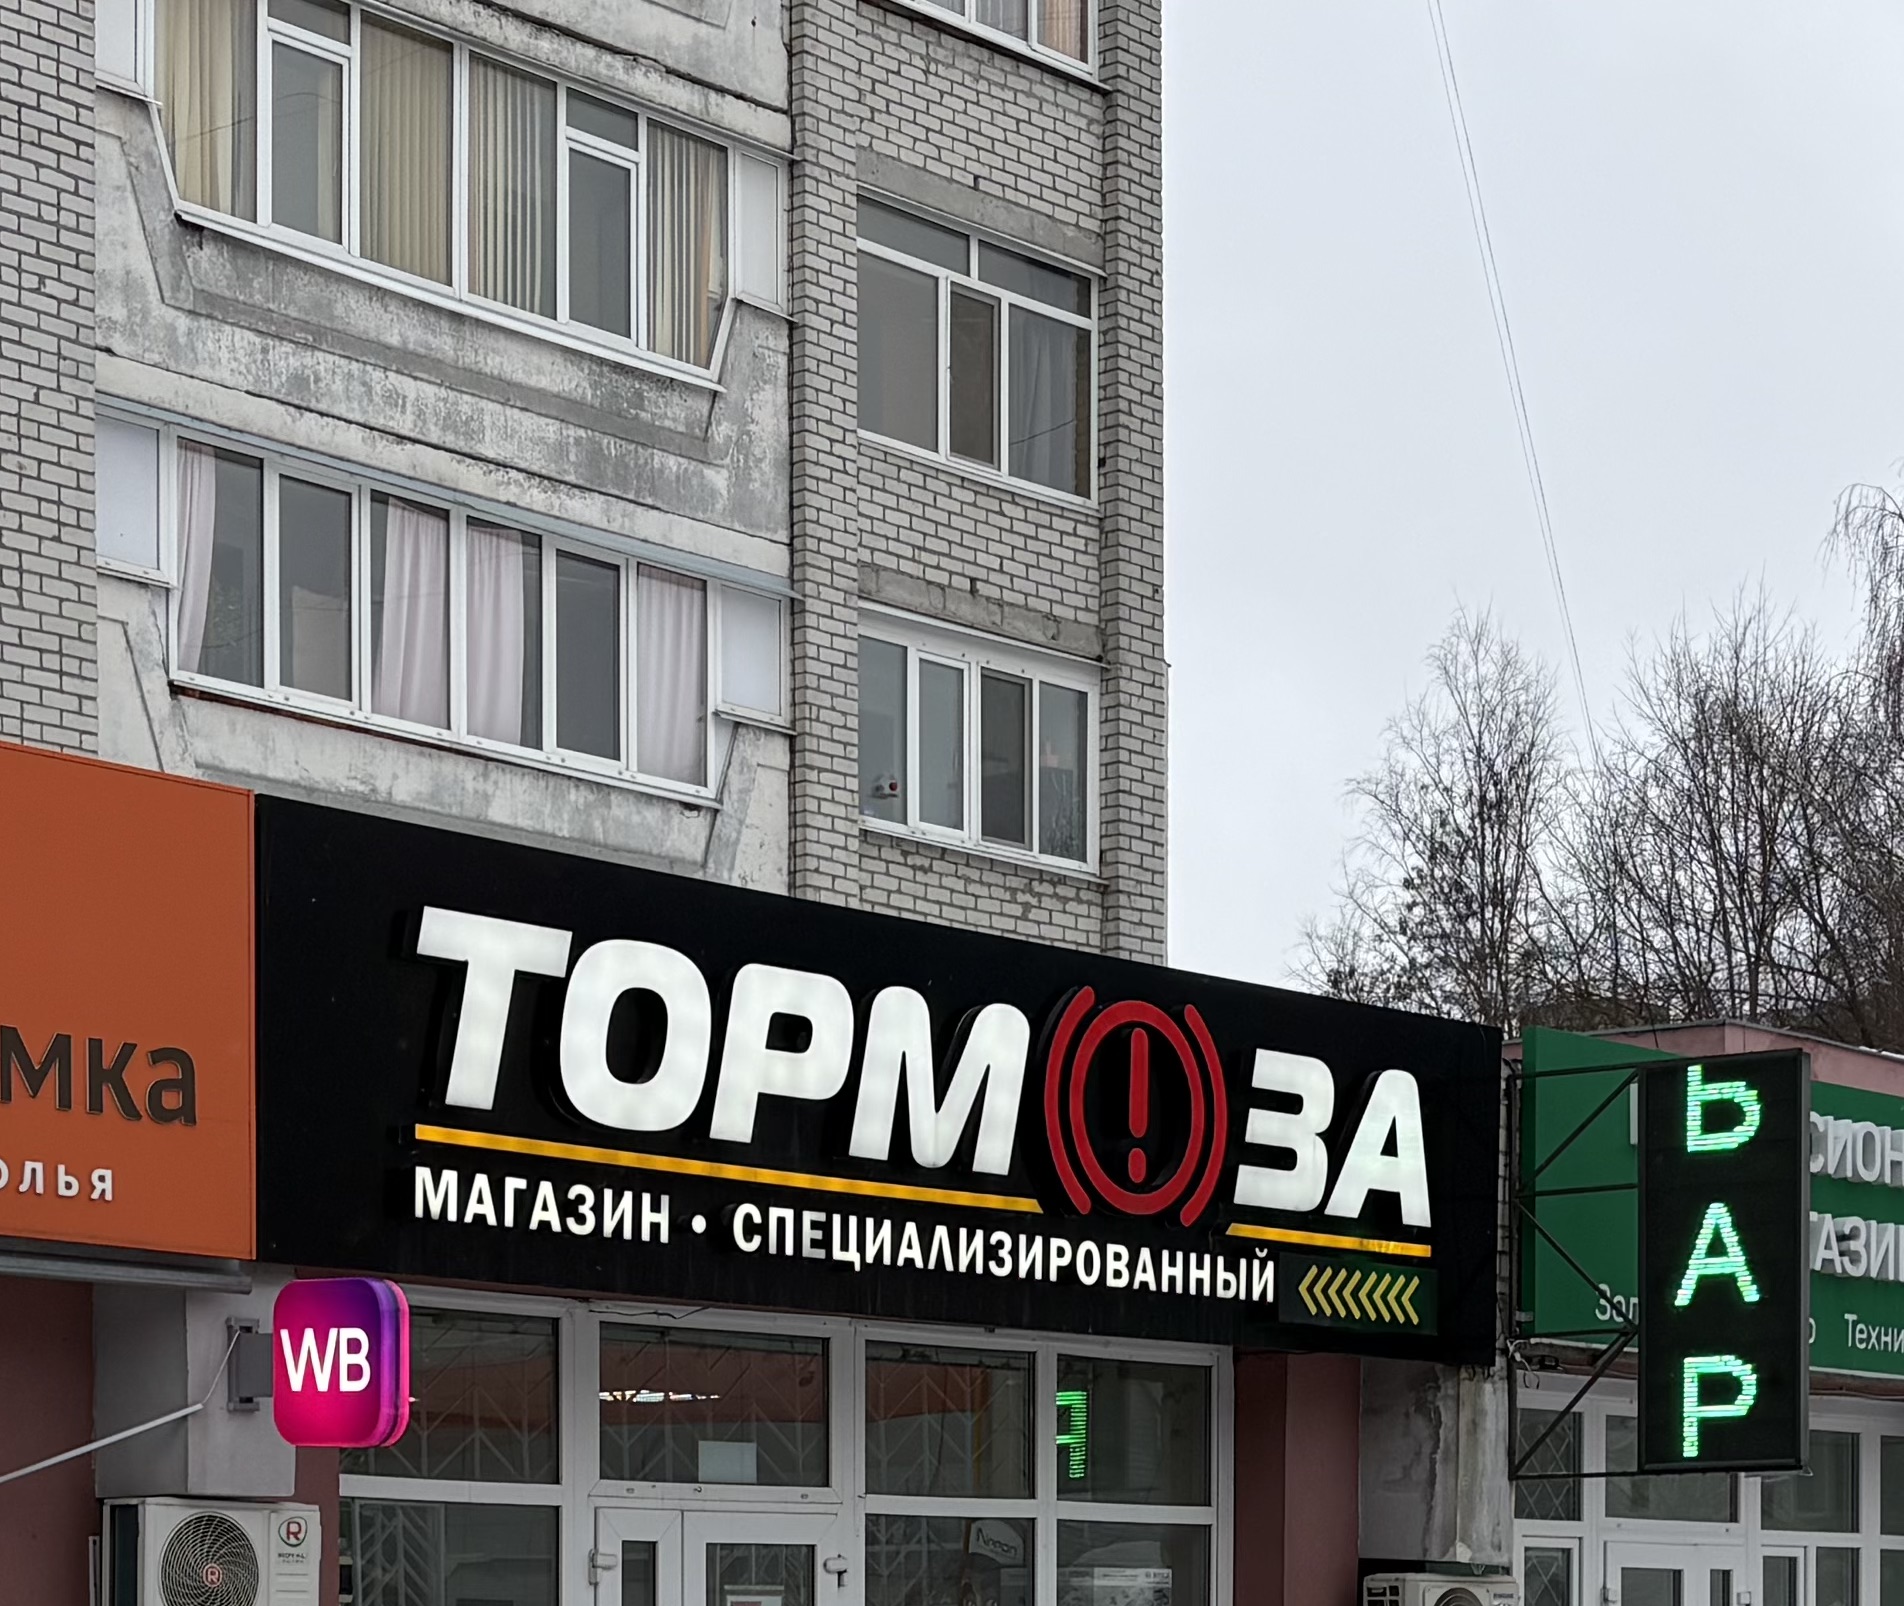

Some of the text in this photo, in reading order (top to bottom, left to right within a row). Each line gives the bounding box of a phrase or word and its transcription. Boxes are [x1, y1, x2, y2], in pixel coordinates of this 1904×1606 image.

[414, 1166, 1276, 1304] МАГАЗИН СПЕЦИАЛИЗИРОВАННЫЙ
[280, 1327, 372, 1392] WB
